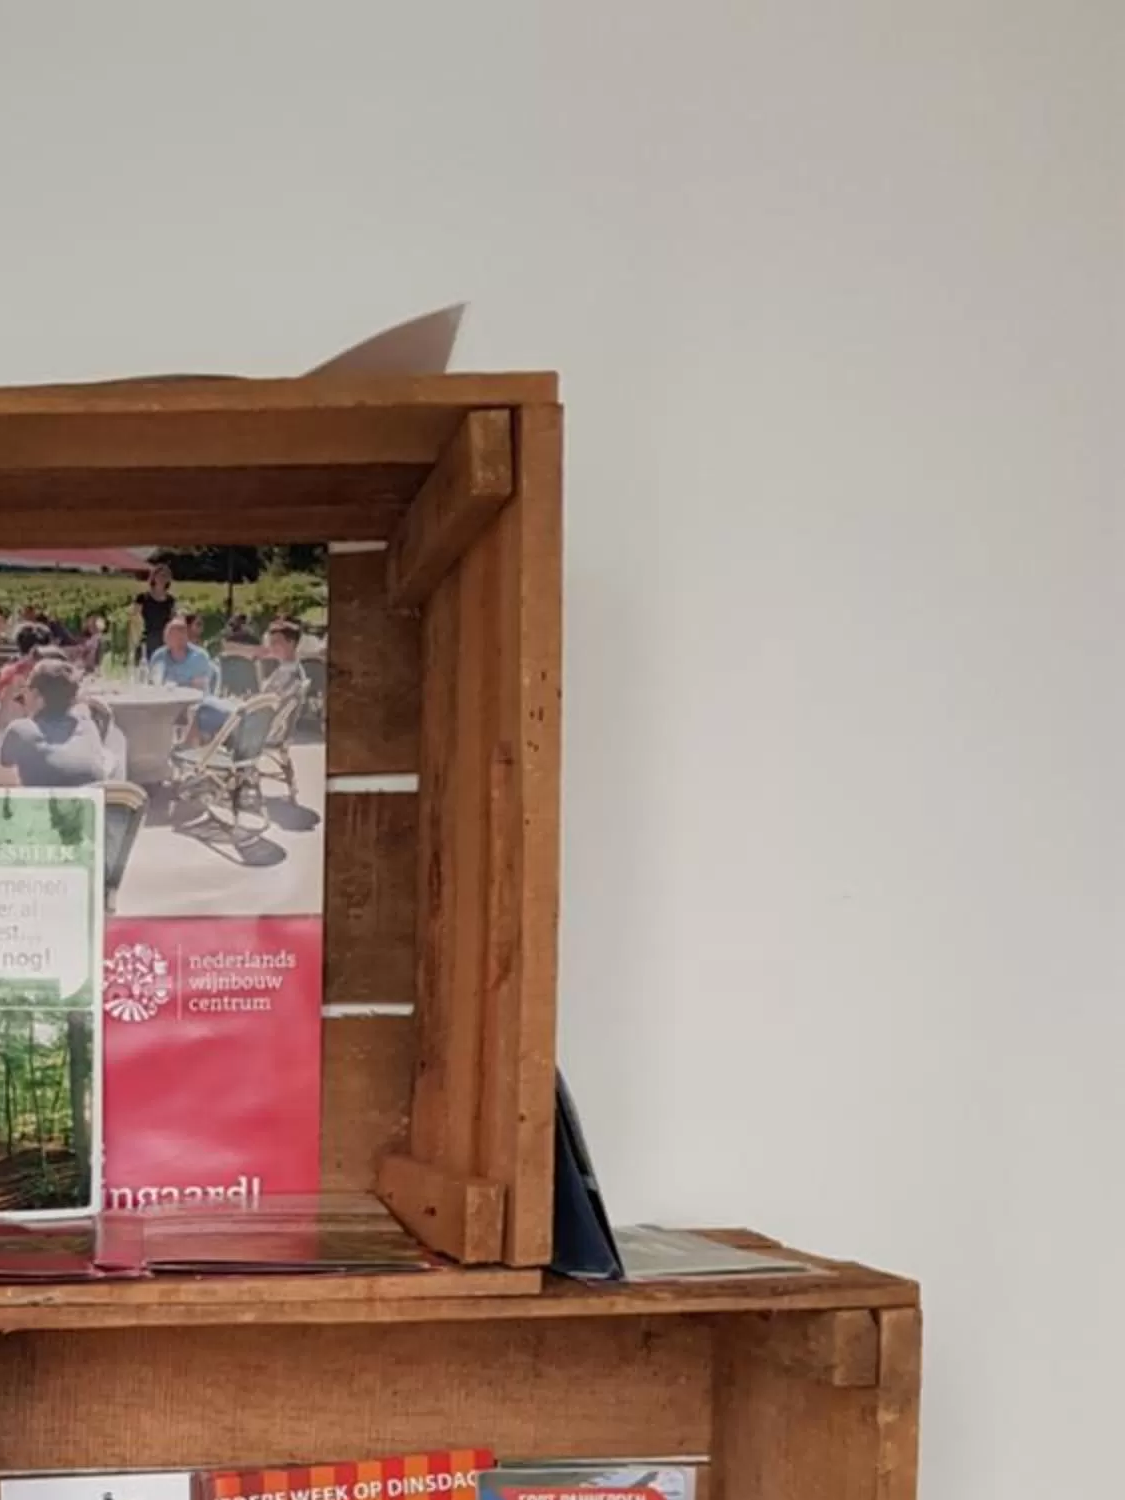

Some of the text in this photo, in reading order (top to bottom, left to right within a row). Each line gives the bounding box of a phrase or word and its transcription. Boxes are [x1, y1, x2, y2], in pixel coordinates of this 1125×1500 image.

[2, 947, 51, 971] nog!
[188, 951, 296, 969] nederlands
[188, 973, 284, 993] wijnbouw
[188, 994, 272, 1012] centrum
[102, 1176, 261, 1211] ngaard!
[353, 1480, 383, 1500] OP
